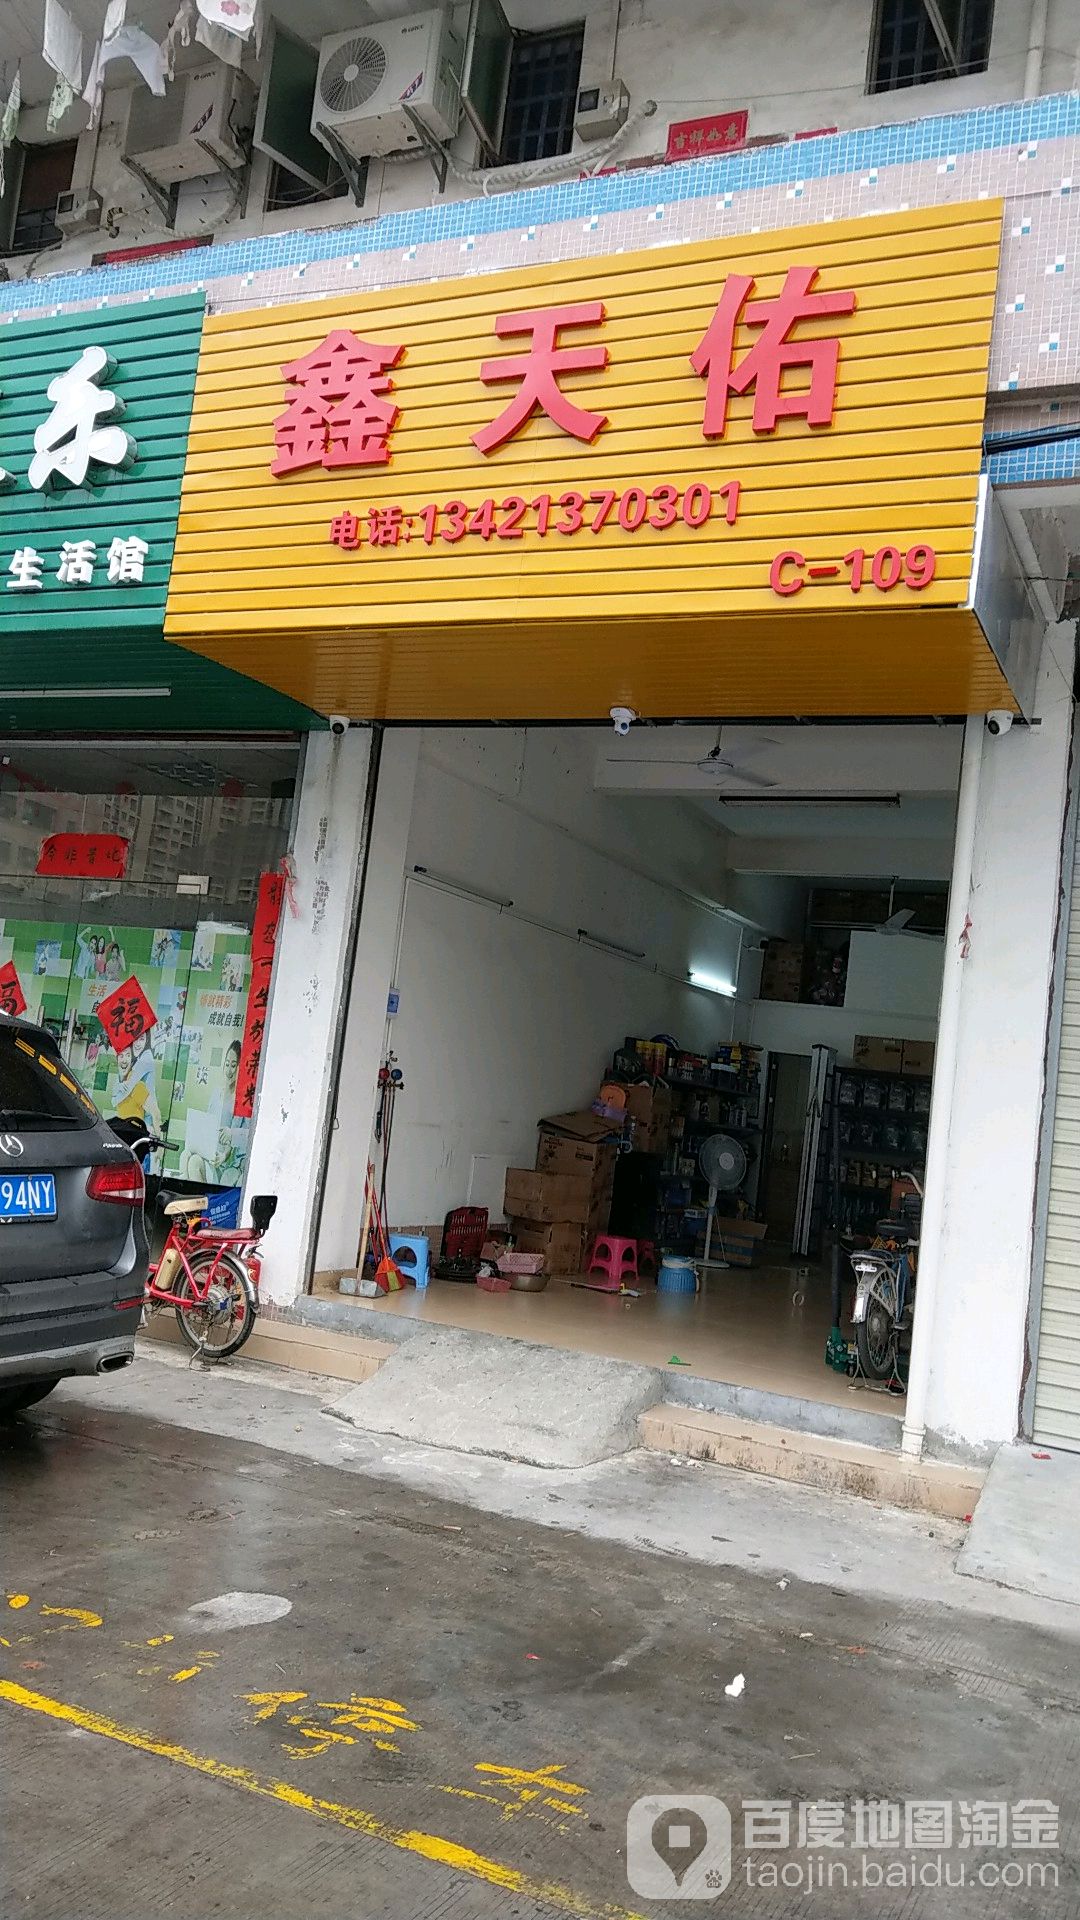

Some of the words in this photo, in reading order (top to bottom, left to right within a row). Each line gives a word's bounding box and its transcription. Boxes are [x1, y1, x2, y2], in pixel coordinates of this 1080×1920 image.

[270, 266, 856, 478] 鑫天佑
[329, 480, 741, 549] 电话:13421370301
[6, 535, 148, 590] 生活馆
[769, 544, 937, 596] C-109
[110, 997, 145, 1039] 福
